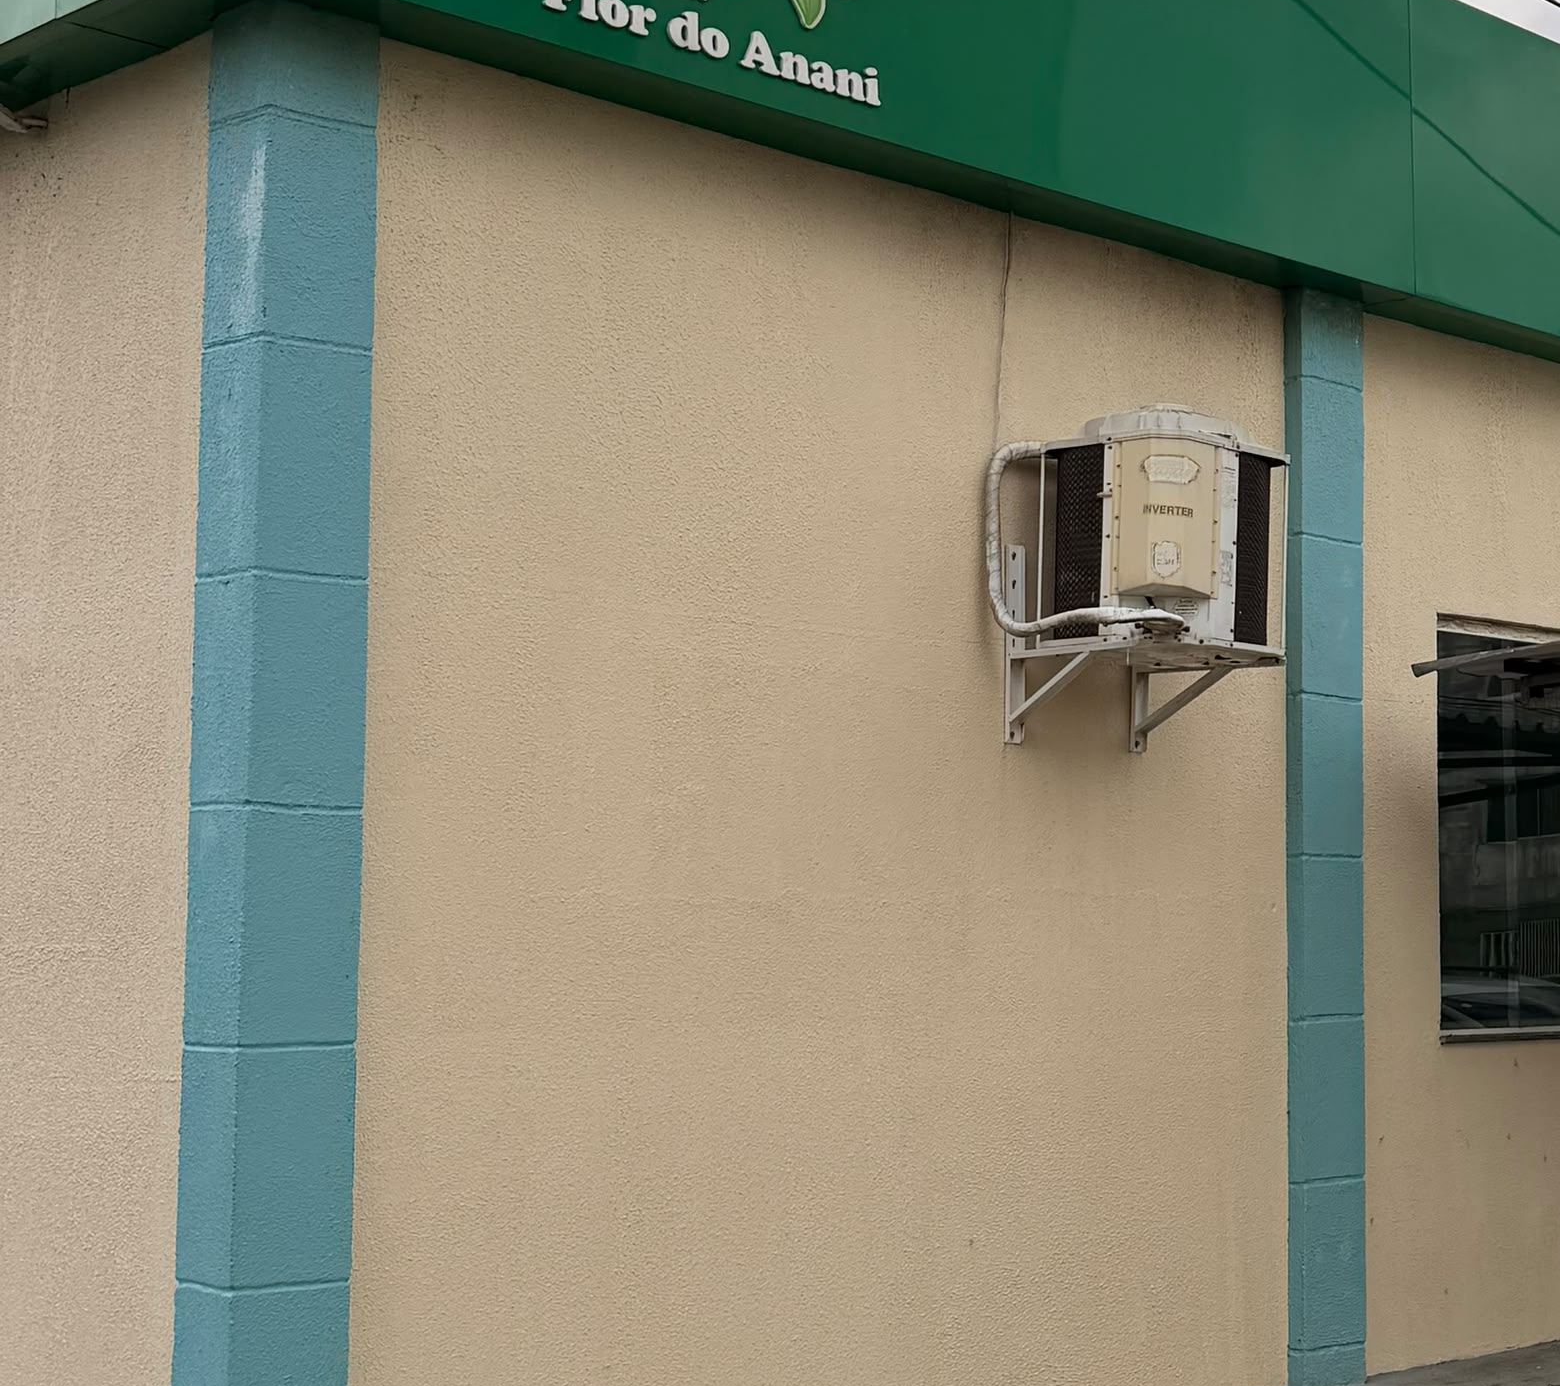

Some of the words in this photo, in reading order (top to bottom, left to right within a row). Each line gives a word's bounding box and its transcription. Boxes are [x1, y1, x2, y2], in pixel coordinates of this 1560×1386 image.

[667, 12, 730, 59] do
[739, 31, 882, 106] Anani
[1142, 503, 1194, 518] INVERTER
